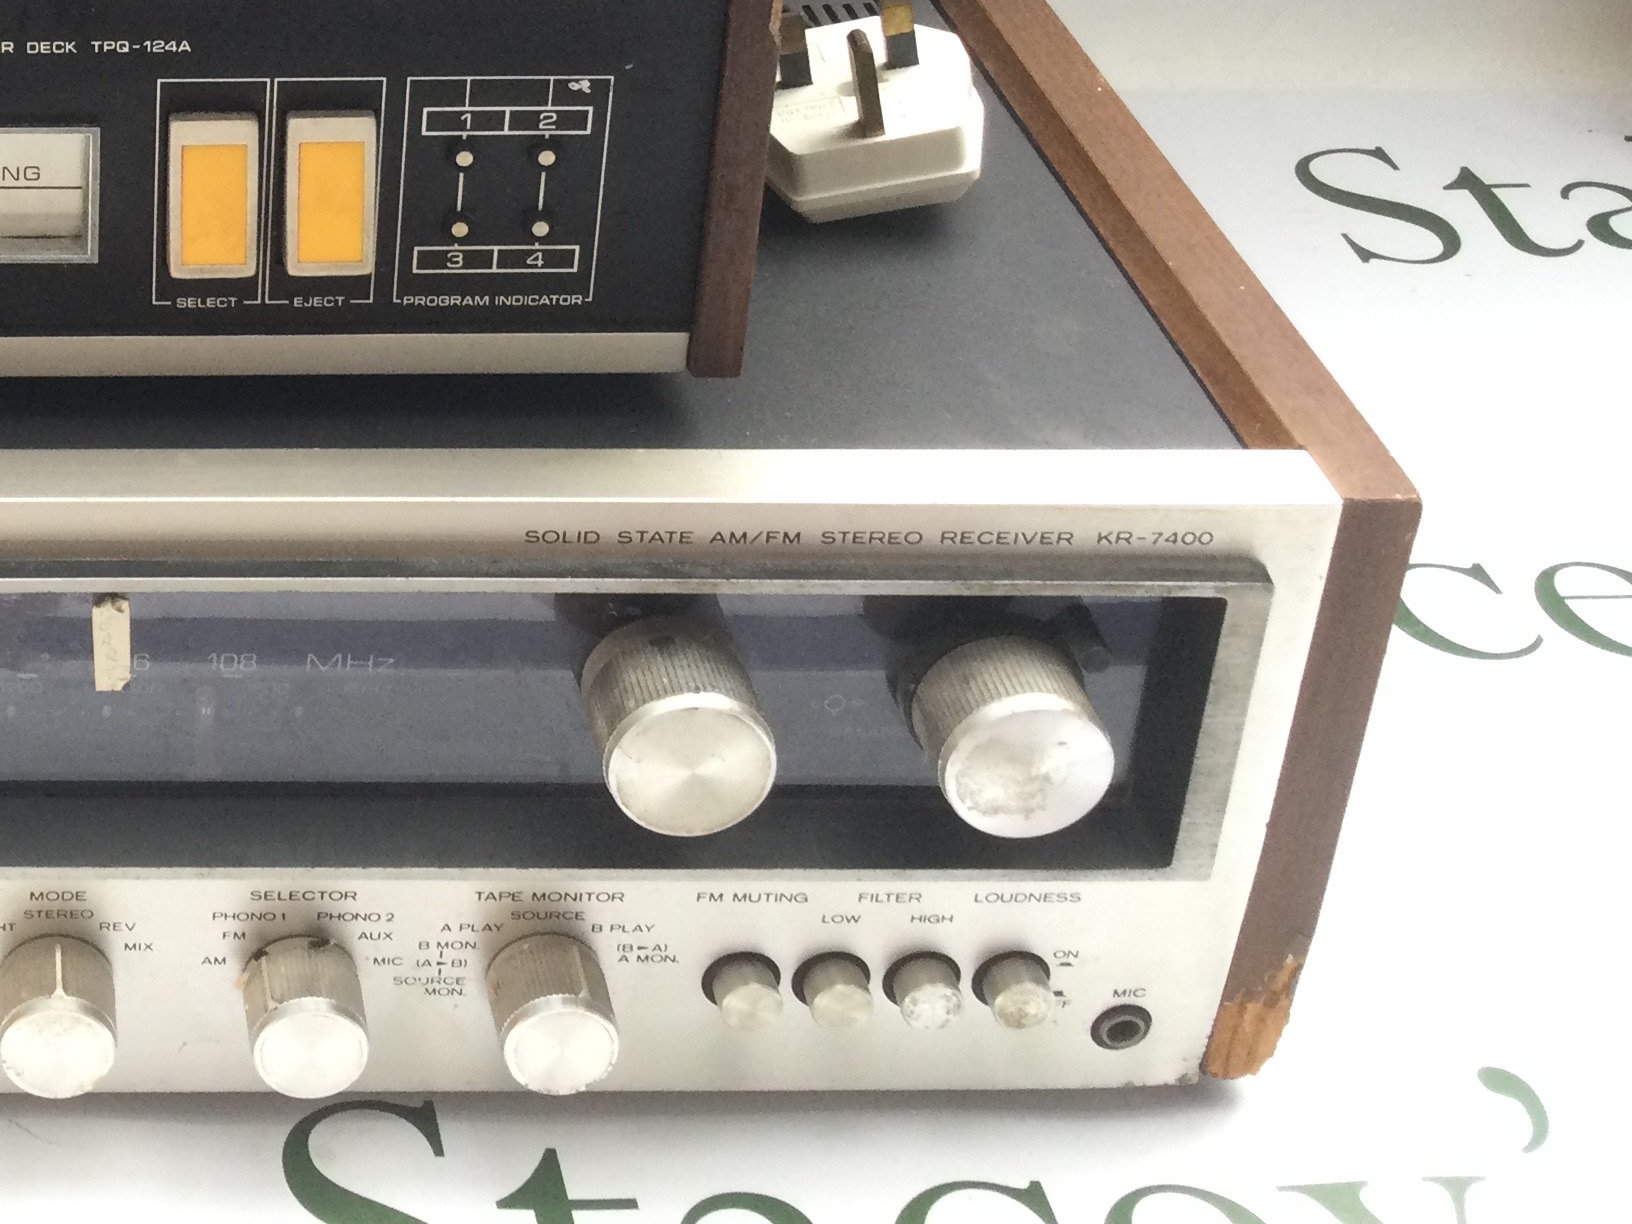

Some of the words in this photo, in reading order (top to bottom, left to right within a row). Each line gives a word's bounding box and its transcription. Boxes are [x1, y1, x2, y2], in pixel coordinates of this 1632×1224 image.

[27, 42, 77, 53] DECK
[91, 40, 191, 52] TPQ-124A
[461, 113, 471, 129] 1
[539, 113, 557, 129] 2
[447, 252, 463, 267] 3
[527, 252, 544, 267] 4
[177, 297, 237, 308] SELECT
[294, 297, 345, 307] EJECT
[404, 296, 489, 306] PROGRAM
[495, 295, 582, 305] INDICATOR
[526, 530, 600, 543] SOLID
[618, 531, 693, 544] STATE
[710, 531, 801, 543] AM/FM
[822, 531, 923, 544] STEREO
[940, 531, 1074, 545] RECEIVER
[1097, 531, 1213, 545] KR-7400
[207, 653, 257, 671] 108
[306, 653, 395, 673] MHz
[30, 891, 86, 901] MODE
[251, 891, 357, 901] SELECTOR
[476, 892, 522, 901] TAPE
[532, 892, 624, 902] MONITOR
[697, 893, 723, 902] FM
[733, 893, 808, 903] MUTING
[858, 893, 922, 903] FILTER
[974, 893, 1081, 903] LOUDNESS
[24, 909, 94, 919] STEREO
[212, 912, 269, 921] PHONO
[317, 912, 381, 922] PHONO
[386, 913, 394, 922] 2
[511, 911, 585, 921] SOURCE
[822, 915, 861, 923] LOW
[911, 915, 953, 923] HIGH
[99, 922, 135, 931] REV
[441, 924, 451, 932] A
[460, 923, 503, 932] PLAY
[592, 924, 602, 932] B
[610, 924, 654, 933] PLAY
[223, 932, 245, 940] FM
[358, 932, 392, 940] AUX
[125, 943, 153, 951] MIX
[419, 941, 430, 950] B
[637, 955, 680, 963] MON.
[1053, 950, 1079, 958] ON
[202, 957, 226, 965] AM
[373, 957, 402, 966] MIC
[393, 977, 465, 985] SOURCE
[1113, 988, 1145, 997] MIC
